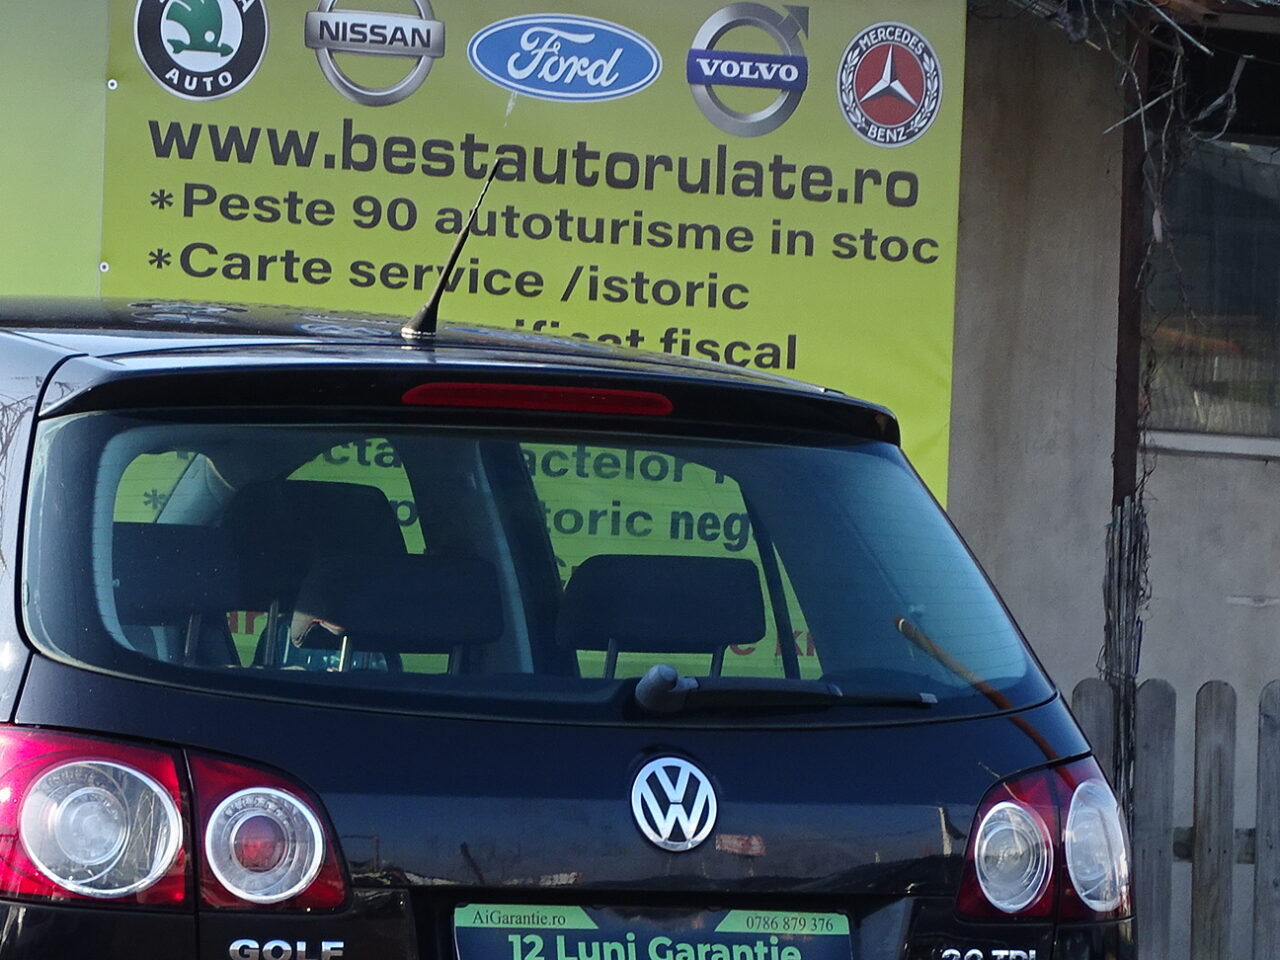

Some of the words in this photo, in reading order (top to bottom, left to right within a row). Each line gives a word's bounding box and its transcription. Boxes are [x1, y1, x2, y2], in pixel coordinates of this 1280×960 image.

[320, 20, 431, 48] NISSAN
[859, 26, 926, 56] MERCEDES
[508, 26, 623, 87] Ford
[696, 58, 799, 82] VOLVO
[165, 69, 233, 92] AUTO
[867, 126, 907, 142] BENZ
[148, 118, 919, 208] www.bestautorulate.ro
[352, 195, 418, 232] 90
[434, 205, 754, 253] autoturisme
[770, 218, 814, 257] in
[831, 227, 940, 264] stoc
[348, 257, 544, 298] service
[559, 264, 750, 310] /istoric
[659, 327, 797, 370] fiscal
[472, 910, 566, 926] AiGarantie.ro
[746, 916, 778, 930] 0786
[783, 917, 807, 931] 879
[811, 918, 834, 932] 376
